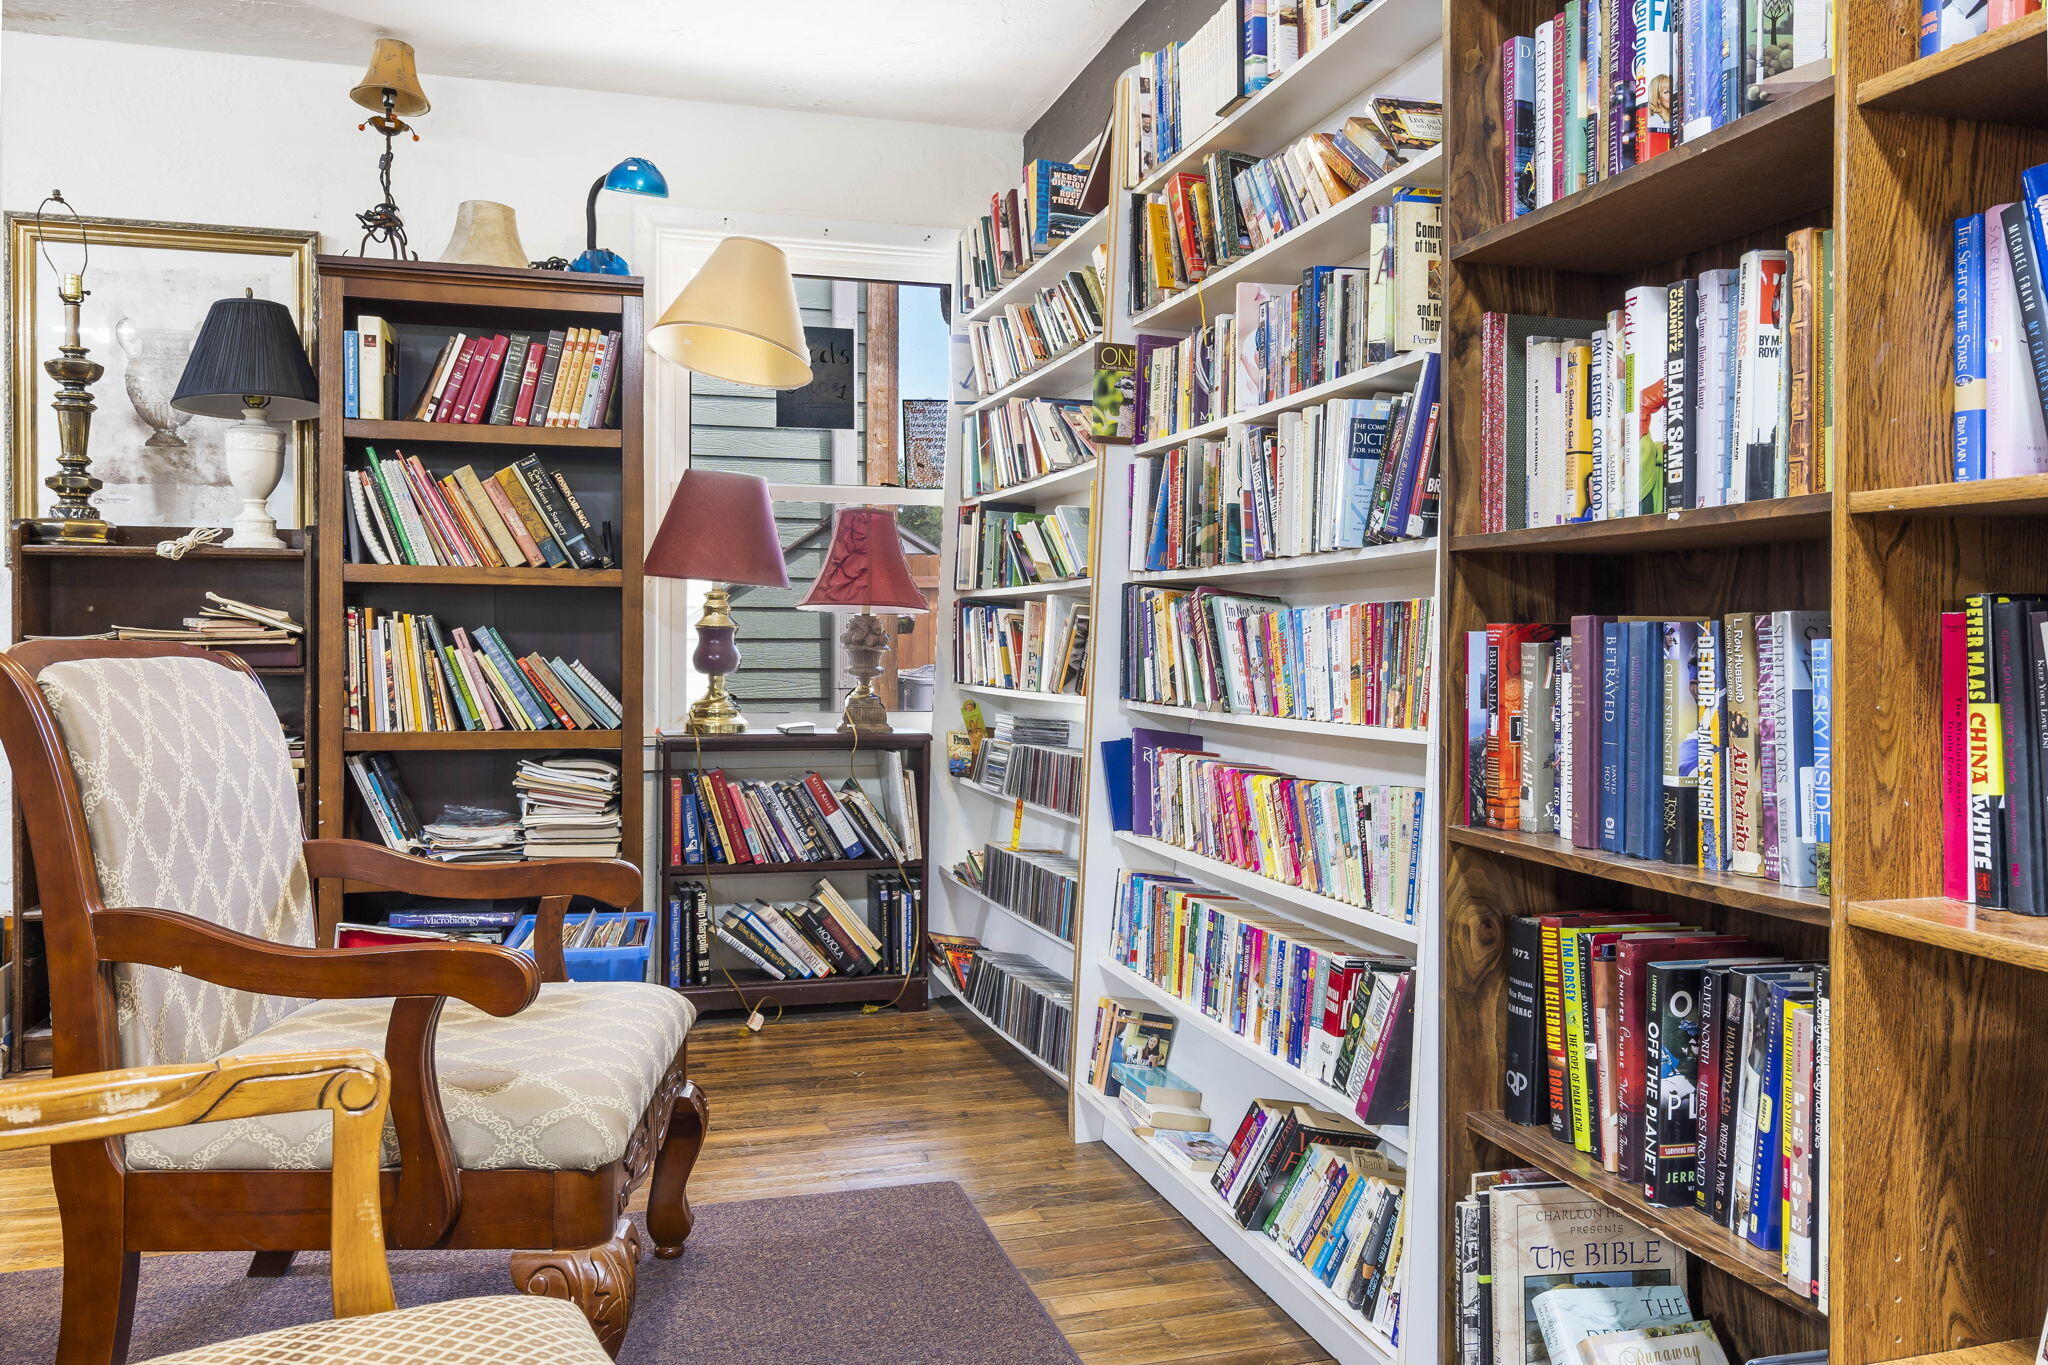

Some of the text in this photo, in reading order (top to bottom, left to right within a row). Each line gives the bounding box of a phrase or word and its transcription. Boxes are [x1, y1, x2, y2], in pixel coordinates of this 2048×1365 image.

[1538, 40, 1546, 94] GERRY
[1424, 240, 1436, 254] the
[2008, 224, 2036, 312] MICHAEL FRAYN
[1417, 303, 1431, 317] and
[1670, 288, 1678, 352] CAUNITZ
[1957, 222, 1972, 371] THE SIGHT OF THE STARS
[1738, 310, 1748, 360] BOSS
[1759, 335, 1772, 346] BY
[2028, 320, 2040, 337] MY
[1592, 338, 1602, 422] PAUL REISER
[1667, 359, 1684, 484] BLACK SAND
[1592, 428, 1602, 510] COUPLEHOOD
[534, 482, 548, 508] Patient
[550, 510, 568, 536] Surgery
[1604, 636, 1616, 722] BETRAYED
[1698, 636, 1716, 707] DETOUR
[1734, 654, 1744, 704] HUBBARD
[1966, 597, 1986, 700] PETER MAAS
[525, 667, 554, 702] Generation
[1554, 674, 1562, 706] HIGGINS
[2037, 659, 2048, 730] KEEP YOUR LOVE
[1554, 708, 1562, 733] CLARK
[1664, 664, 1673, 772] QUIET STRENGTH
[1774, 624, 1788, 844] SPIRIT WARRIORS WEBER
[1814, 693, 1829, 741] SKY
[1698, 726, 1714, 821] JAMES SIEGEL
[1814, 746, 1831, 826] INSIDE
[1970, 712, 1992, 870] CHINA WHITE
[777, 792, 809, 844] Book Yourself Solid
[1670, 797, 1678, 830] TONY
[1734, 780, 1750, 852] Pedrito
[424, 916, 480, 926] Microbiology
[696, 892, 708, 954] Phillip Margolin
[814, 925, 847, 959] MOVIOLA
[802, 950, 821, 969] OATH
[1512, 948, 1530, 960] 1972
[1562, 937, 1576, 1002] TIM DORSEY
[1542, 926, 1562, 1052] JONATHAN KELLERMAN
[1582, 1001, 1590, 1036] WATER
[1617, 964, 1631, 1025] JENNIFER
[1699, 976, 1712, 1064] OLIVER NORTH
[1568, 1033, 1582, 1100] THE POPE PALM
[1723, 1025, 1736, 1087] HUMANITY
[1548, 1068, 1564, 1110] BONES
[1645, 1022, 1660, 1176] OFF THE PLANET
[1357, 1158, 1382, 1170] Thank
[1696, 1082, 1708, 1187] HEROES PROVED
[1714, 1122, 1728, 1196] ROBERT PYNE
[1536, 1208, 1602, 1222] CHARLTON
[1791, 1162, 1804, 1232] LOVE
[1530, 1240, 1662, 1271] The BIBLE
[1641, 1298, 1688, 1316] THE
